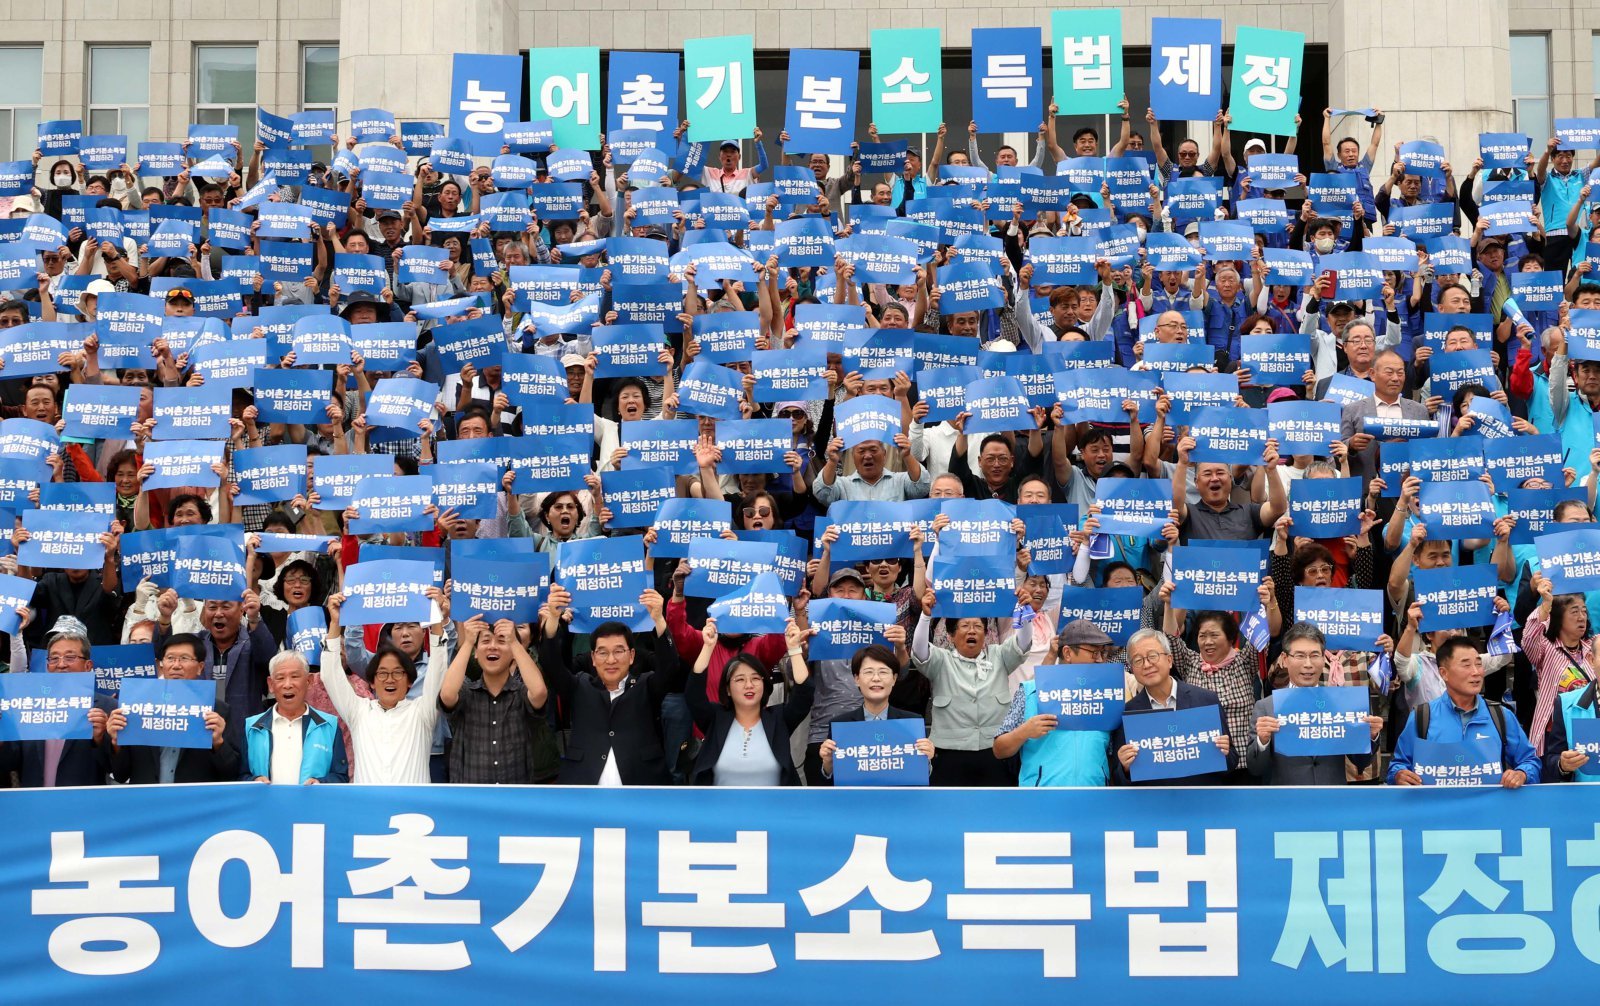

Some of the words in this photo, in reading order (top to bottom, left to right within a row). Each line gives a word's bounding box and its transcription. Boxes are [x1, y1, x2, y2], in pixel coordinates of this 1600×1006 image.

[1064, 36, 1110, 89] 법
[1159, 45, 1211, 95] 제
[882, 58, 932, 103] 소
[982, 55, 1032, 107] 득
[1242, 55, 1290, 110] 정
[697, 62, 742, 113] 기
[541, 73, 588, 124] 어
[618, 75, 667, 131] 촌
[796, 76, 846, 128] 본
[460, 81, 510, 133] 농
[90, 154, 114, 162] 제정하라
[860, 152, 906, 161] 농어촌기본소득법
[1261, 172, 1286, 180] 제정하라
[373, 192, 399, 200] 제정하라
[1032, 195, 1058, 203] 제정하라
[1321, 194, 1346, 202] 제정하라
[546, 202, 571, 211] 제정하라
[789, 245, 822, 254] 제정하라
[1216, 242, 1242, 251] 제정하라
[271, 264, 298, 273] 제정하라
[622, 264, 656, 274] 제정하라
[866, 262, 900, 272] 제정하라
[1047, 264, 1081, 273] 제정하라
[347, 276, 374, 286] 제정하라
[527, 290, 561, 300] 제정하라
[956, 288, 989, 300] 제정하라
[1526, 293, 1552, 301] 제정하라
[614, 302, 681, 312] 농어촌기본소득법
[97, 310, 162, 326] 농어촌기본소득법
[630, 310, 665, 321] 제정하라
[109, 322, 144, 333] 제정하라
[303, 342, 340, 353] 제정하라
[438, 332, 504, 354] 농어촌기본소득법
[711, 340, 745, 351] 제정하라
[13, 350, 51, 362] 제정하라
[104, 346, 138, 356] 제정하라
[363, 348, 398, 359] 제정하라
[455, 348, 490, 362] 제정하라
[844, 347, 912, 358] 농어촌기본소득법
[1243, 352, 1309, 362] 농어촌기본소득법
[196, 356, 265, 371] 농어촌기본소득법
[612, 353, 648, 364] 제정하라
[859, 357, 894, 368] 제정하라
[211, 366, 247, 378] 제정하라
[754, 366, 826, 378] 농어촌기본소득법
[1260, 362, 1294, 372] 제정하라
[1432, 366, 1494, 382] 농어촌기본소득법
[772, 377, 808, 388] 제정하라
[256, 388, 330, 399] 농어촌기본소득법
[519, 384, 556, 395] 제정하라
[1059, 388, 1128, 400] 농어촌기본소득법
[689, 390, 726, 406] 제정하라
[1078, 398, 1110, 409] 제정하라
[66, 403, 136, 416] 농어촌기본소득법
[154, 406, 230, 416] 농어촌기본소득법
[274, 400, 312, 412] 제정하라
[981, 406, 1019, 419] 제정하라
[81, 416, 118, 427] 제정하라
[172, 416, 211, 426] 제정하라
[1269, 420, 1340, 432] 농어촌기본소득법
[524, 424, 593, 434] 농어촌기본소득법
[1190, 426, 1266, 440] 농어촌기본소득법
[1383, 426, 1420, 436] 제정하라
[1285, 431, 1323, 442] 제정하라
[718, 438, 791, 449] 농어촌기본소득법
[1209, 439, 1248, 450] 제정하라
[640, 450, 679, 462] 제정하라
[735, 449, 773, 460] 제정하라
[512, 454, 588, 468] 농어촌기본소득법
[1412, 457, 1483, 470] 농어촌기본소득법
[1487, 453, 1562, 469] 농어촌기본소득법
[161, 464, 201, 476] 제정하라
[236, 464, 306, 480] 농어촌기본소득법
[531, 468, 570, 479] 제정하라
[1431, 470, 1469, 481] 제정하라
[1506, 466, 1544, 479] 제정하라
[252, 475, 289, 490] 제정하라
[438, 494, 477, 506] 제정하라
[605, 487, 675, 502] 농어촌기본소득법
[352, 495, 431, 508] 농어촌기본소득법
[1096, 499, 1172, 511] 농어촌기본소득법
[370, 507, 411, 518] 제정하라
[1310, 512, 1348, 524] 제정하라
[1442, 514, 1481, 525] 제정하라
[852, 534, 892, 546] 제정하라
[961, 532, 1000, 543] 제정하라
[40, 543, 83, 555] 제정하라
[1035, 549, 1062, 561] 제정하라
[560, 561, 643, 578] 농어촌기본소득법
[189, 572, 233, 585] 제정하라
[576, 574, 622, 590] 제정하라
[1174, 569, 1259, 584] 농어촌기본소득법
[453, 580, 538, 596] 농어촌기본소득법
[934, 577, 1015, 590] 농어촌기본소득법
[1194, 582, 1237, 595] 제정하라
[953, 591, 996, 603] 제정하라
[1418, 585, 1496, 604] 농어촌기본소득법
[362, 595, 408, 608] 제정하라
[470, 597, 516, 611] 제정하라
[591, 606, 634, 618] 제정하라
[730, 604, 776, 617] 제정하라
[1062, 606, 1140, 620] 농어촌기본소득법
[1438, 602, 1478, 615] 제정하라
[1296, 610, 1381, 623] 농어촌기본소득법
[831, 633, 873, 645] 제정하라
[1039, 688, 1123, 702] 농어촌기본소득법
[0, 697, 91, 711] 농어촌기본소득법
[1061, 702, 1104, 716] 제정하라
[20, 710, 68, 724] 제정하라
[142, 718, 188, 731] 제정하라
[1299, 725, 1345, 738] 제정하라
[1153, 749, 1200, 764] 제정하라
[858, 758, 904, 772] 제정하라
[1414, 762, 1502, 777] 농어촌기본소득법
[32, 814, 1238, 977] 농어촌기본소득법
